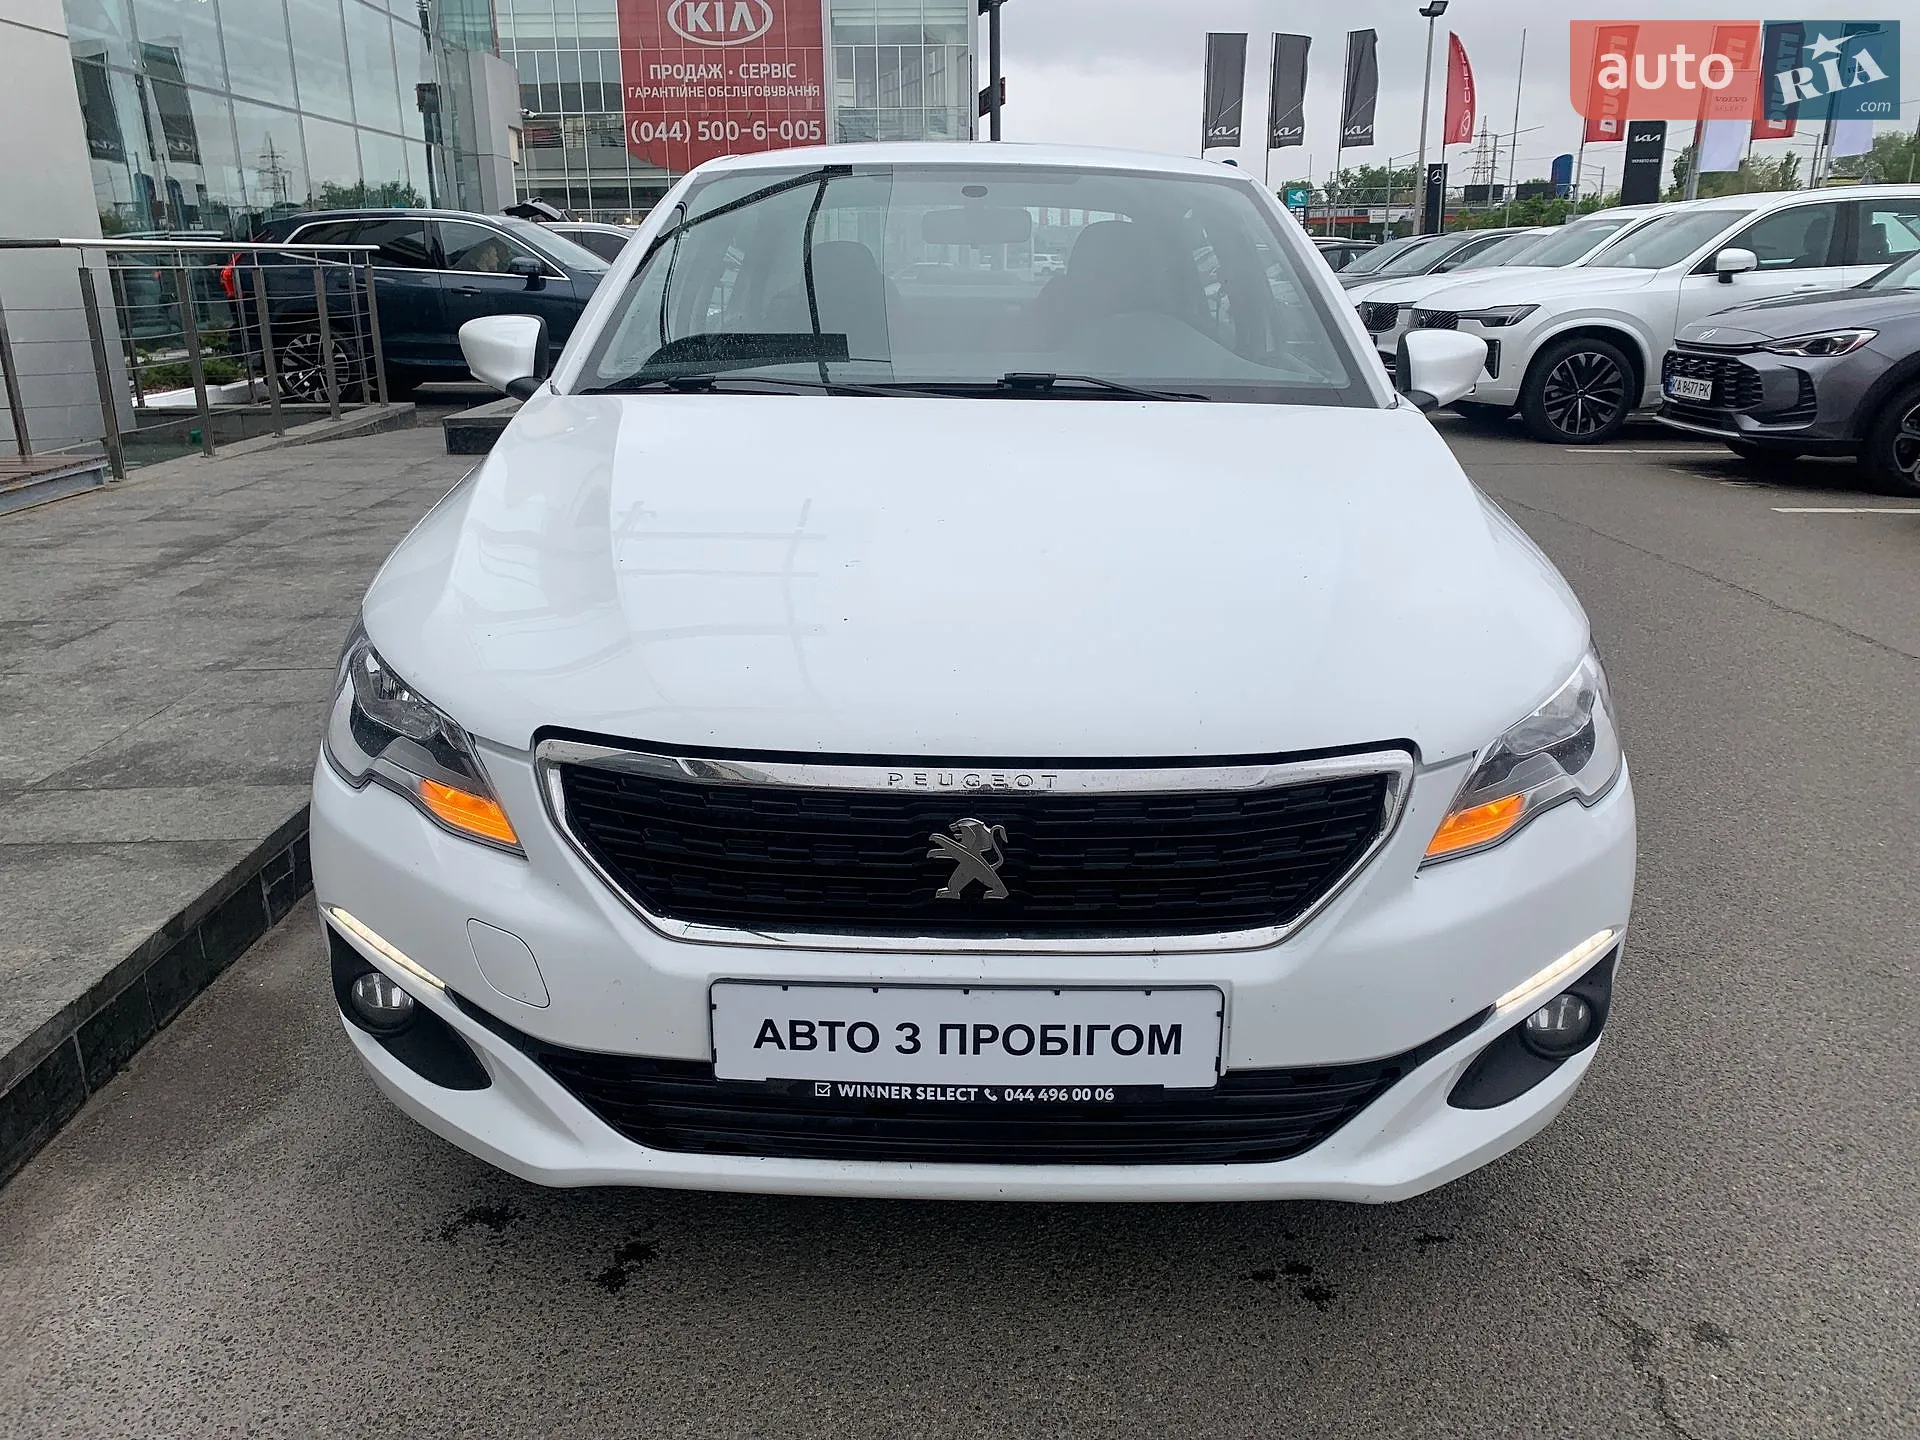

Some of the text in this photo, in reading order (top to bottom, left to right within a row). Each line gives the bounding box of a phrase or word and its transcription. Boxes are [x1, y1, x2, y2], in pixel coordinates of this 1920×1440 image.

[686, 2, 756, 32] KIA
[649, 63, 797, 83] ПРОДАЖ СЕРВІС
[1600, 35, 1628, 133] DUTI
[628, 84, 820, 98] ГАРАНТІЙНЕ ОБСЛУГОВУВАННЯ
[631, 119, 822, 144] (044) 500-6-005
[887, 772, 1058, 788] PEUGEOT
[753, 1018, 880, 1053] АВТО
[939, 1023, 1183, 1056] ПРОБІГОМ
[837, 1083, 1115, 1102] WINNER SELECT 044 496 00 06
